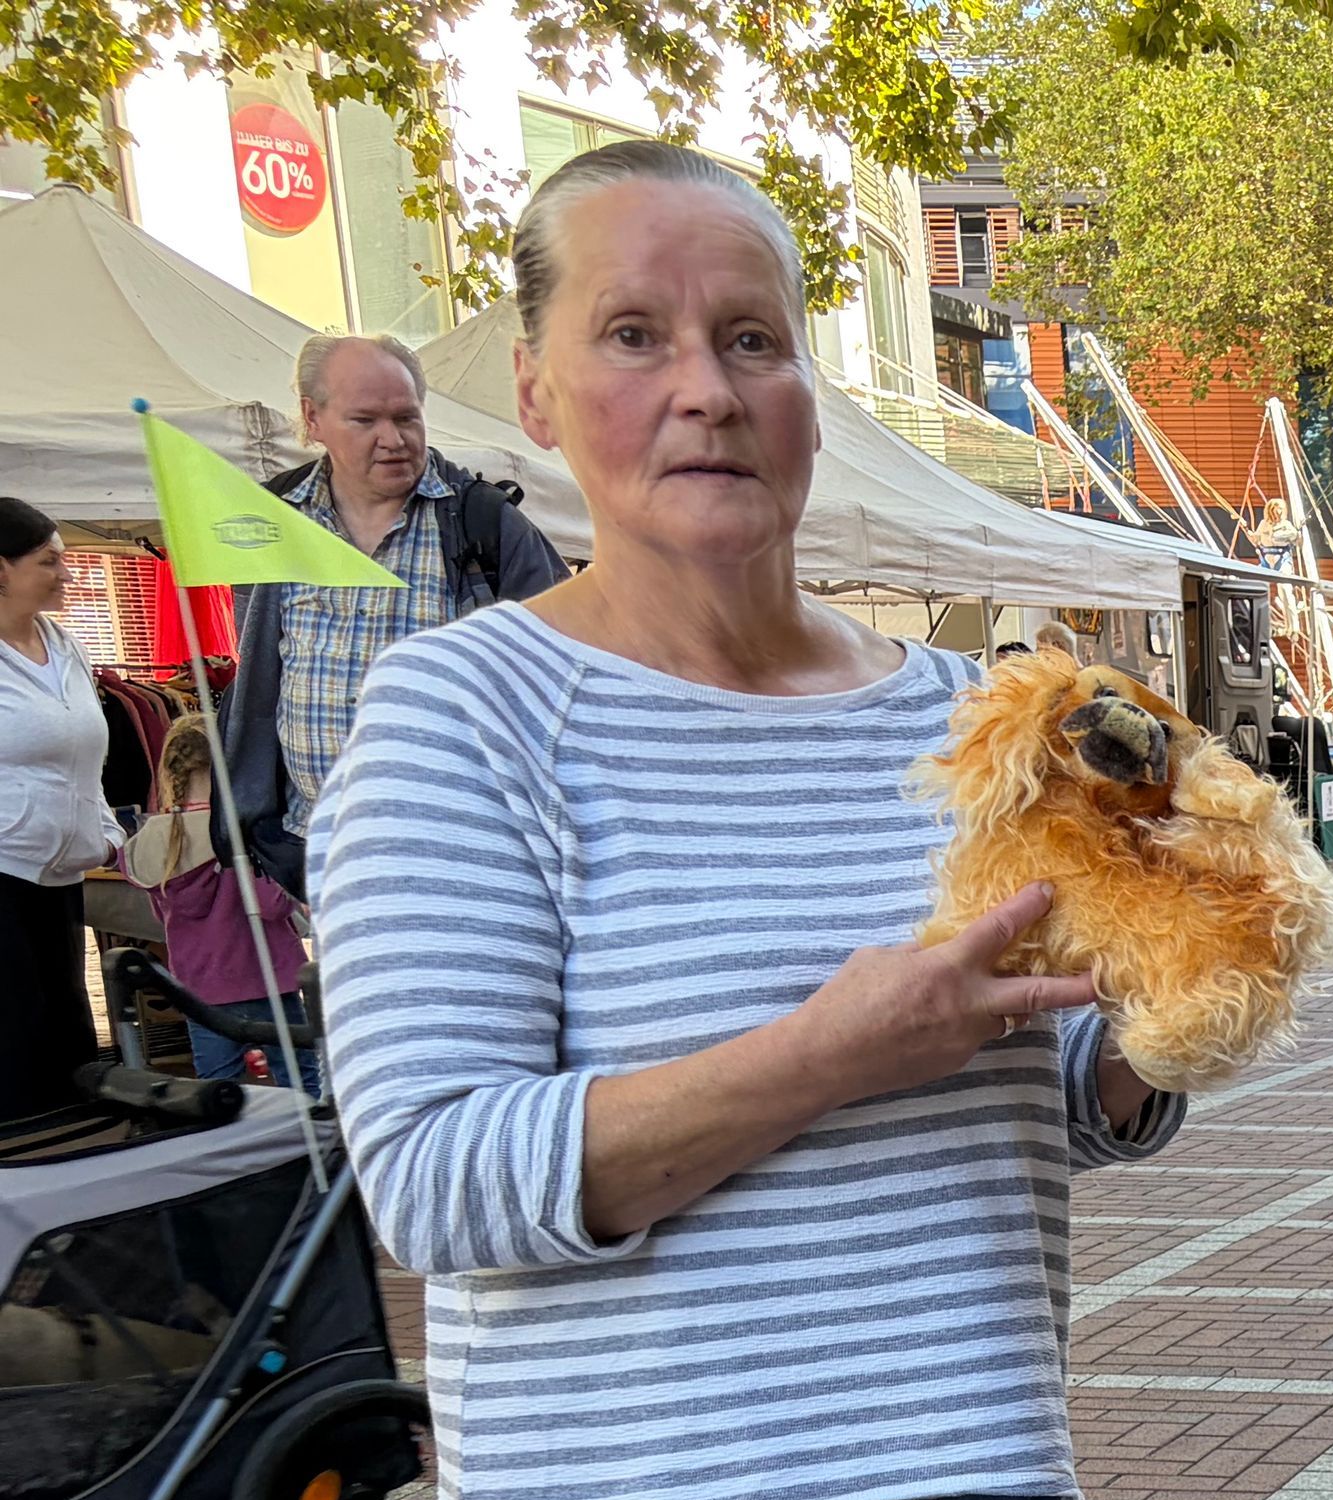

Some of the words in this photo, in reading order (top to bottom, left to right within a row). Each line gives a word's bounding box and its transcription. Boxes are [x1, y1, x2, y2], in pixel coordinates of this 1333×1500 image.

[237, 131, 273, 150] IMMER
[275, 138, 293, 154] BIS
[295, 141, 309, 157] ZU
[242, 151, 313, 198] 60%
